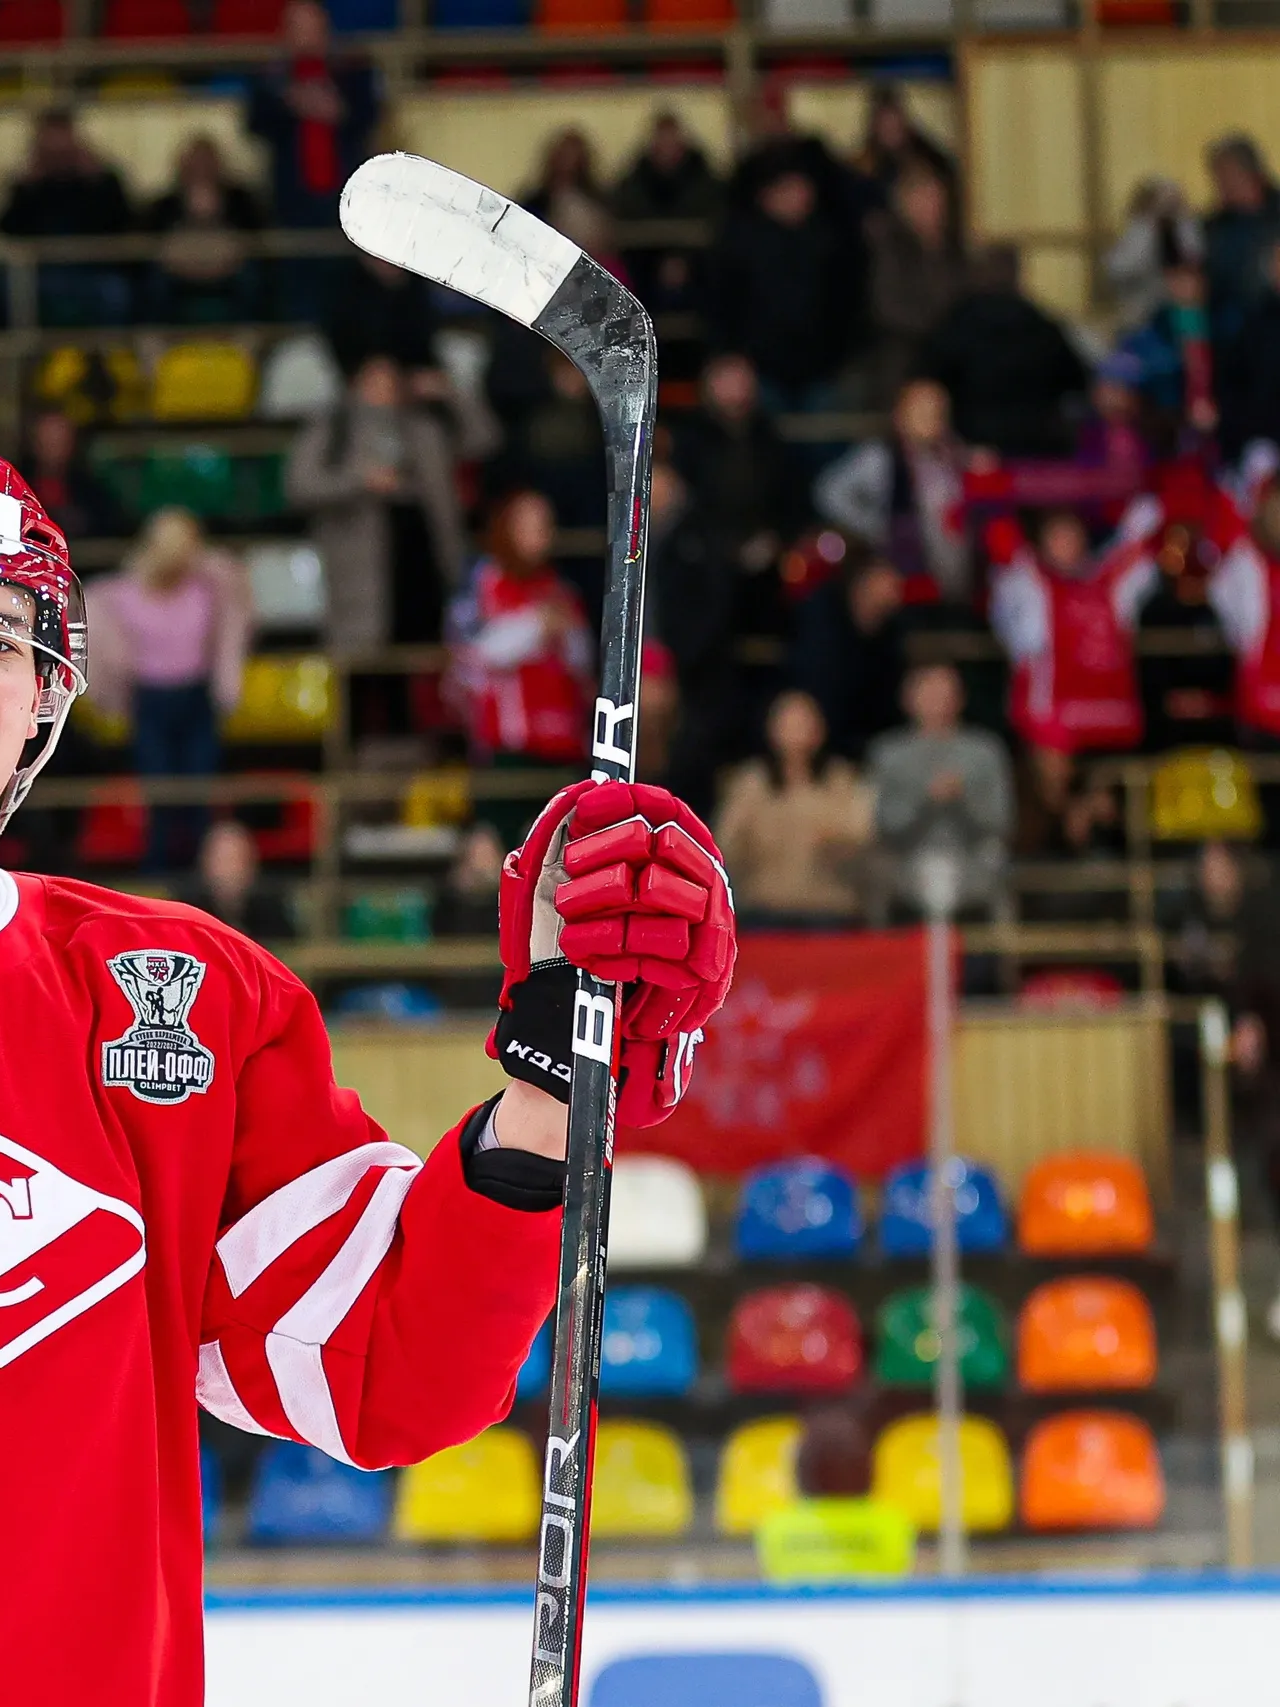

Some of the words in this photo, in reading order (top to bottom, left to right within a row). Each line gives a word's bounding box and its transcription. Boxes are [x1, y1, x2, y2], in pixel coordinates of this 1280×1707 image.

[146, 1041, 177, 1050] 2022/2023
[109, 1049, 209, 1085] ПЛЕЙ-ОФФ
[140, 1082, 181, 1092] OLIMPBET
